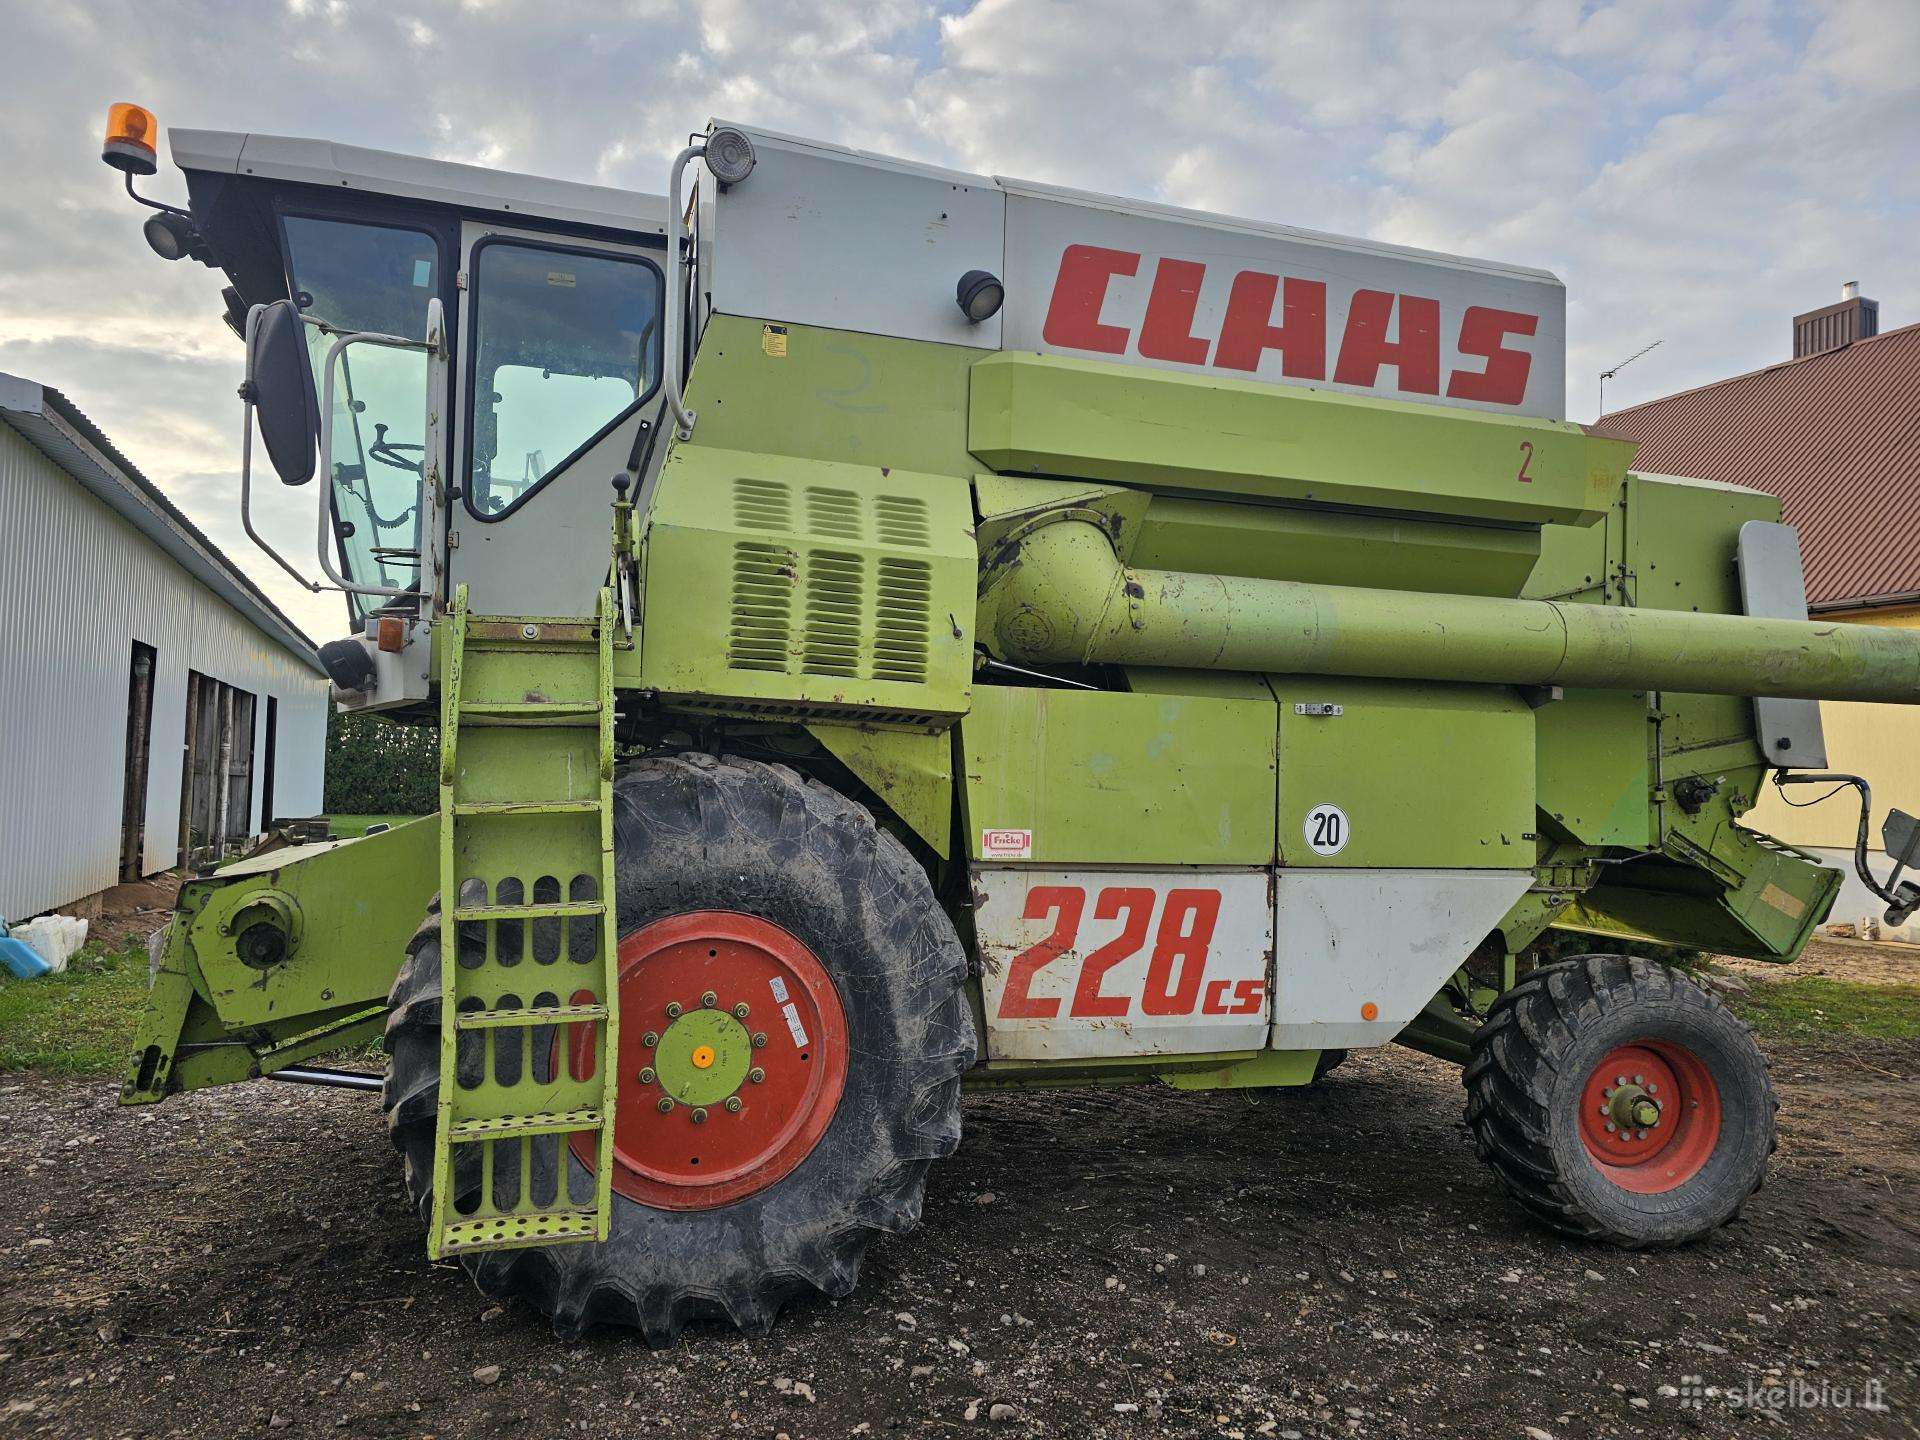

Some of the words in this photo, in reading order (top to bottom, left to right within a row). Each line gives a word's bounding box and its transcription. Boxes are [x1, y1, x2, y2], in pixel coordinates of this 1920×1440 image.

[1042, 243, 1539, 406] CLAAS
[1518, 441, 1534, 483] 2
[994, 834, 1021, 844] Fricke
[1313, 812, 1340, 846] 20
[997, 886, 1222, 1017] 228
